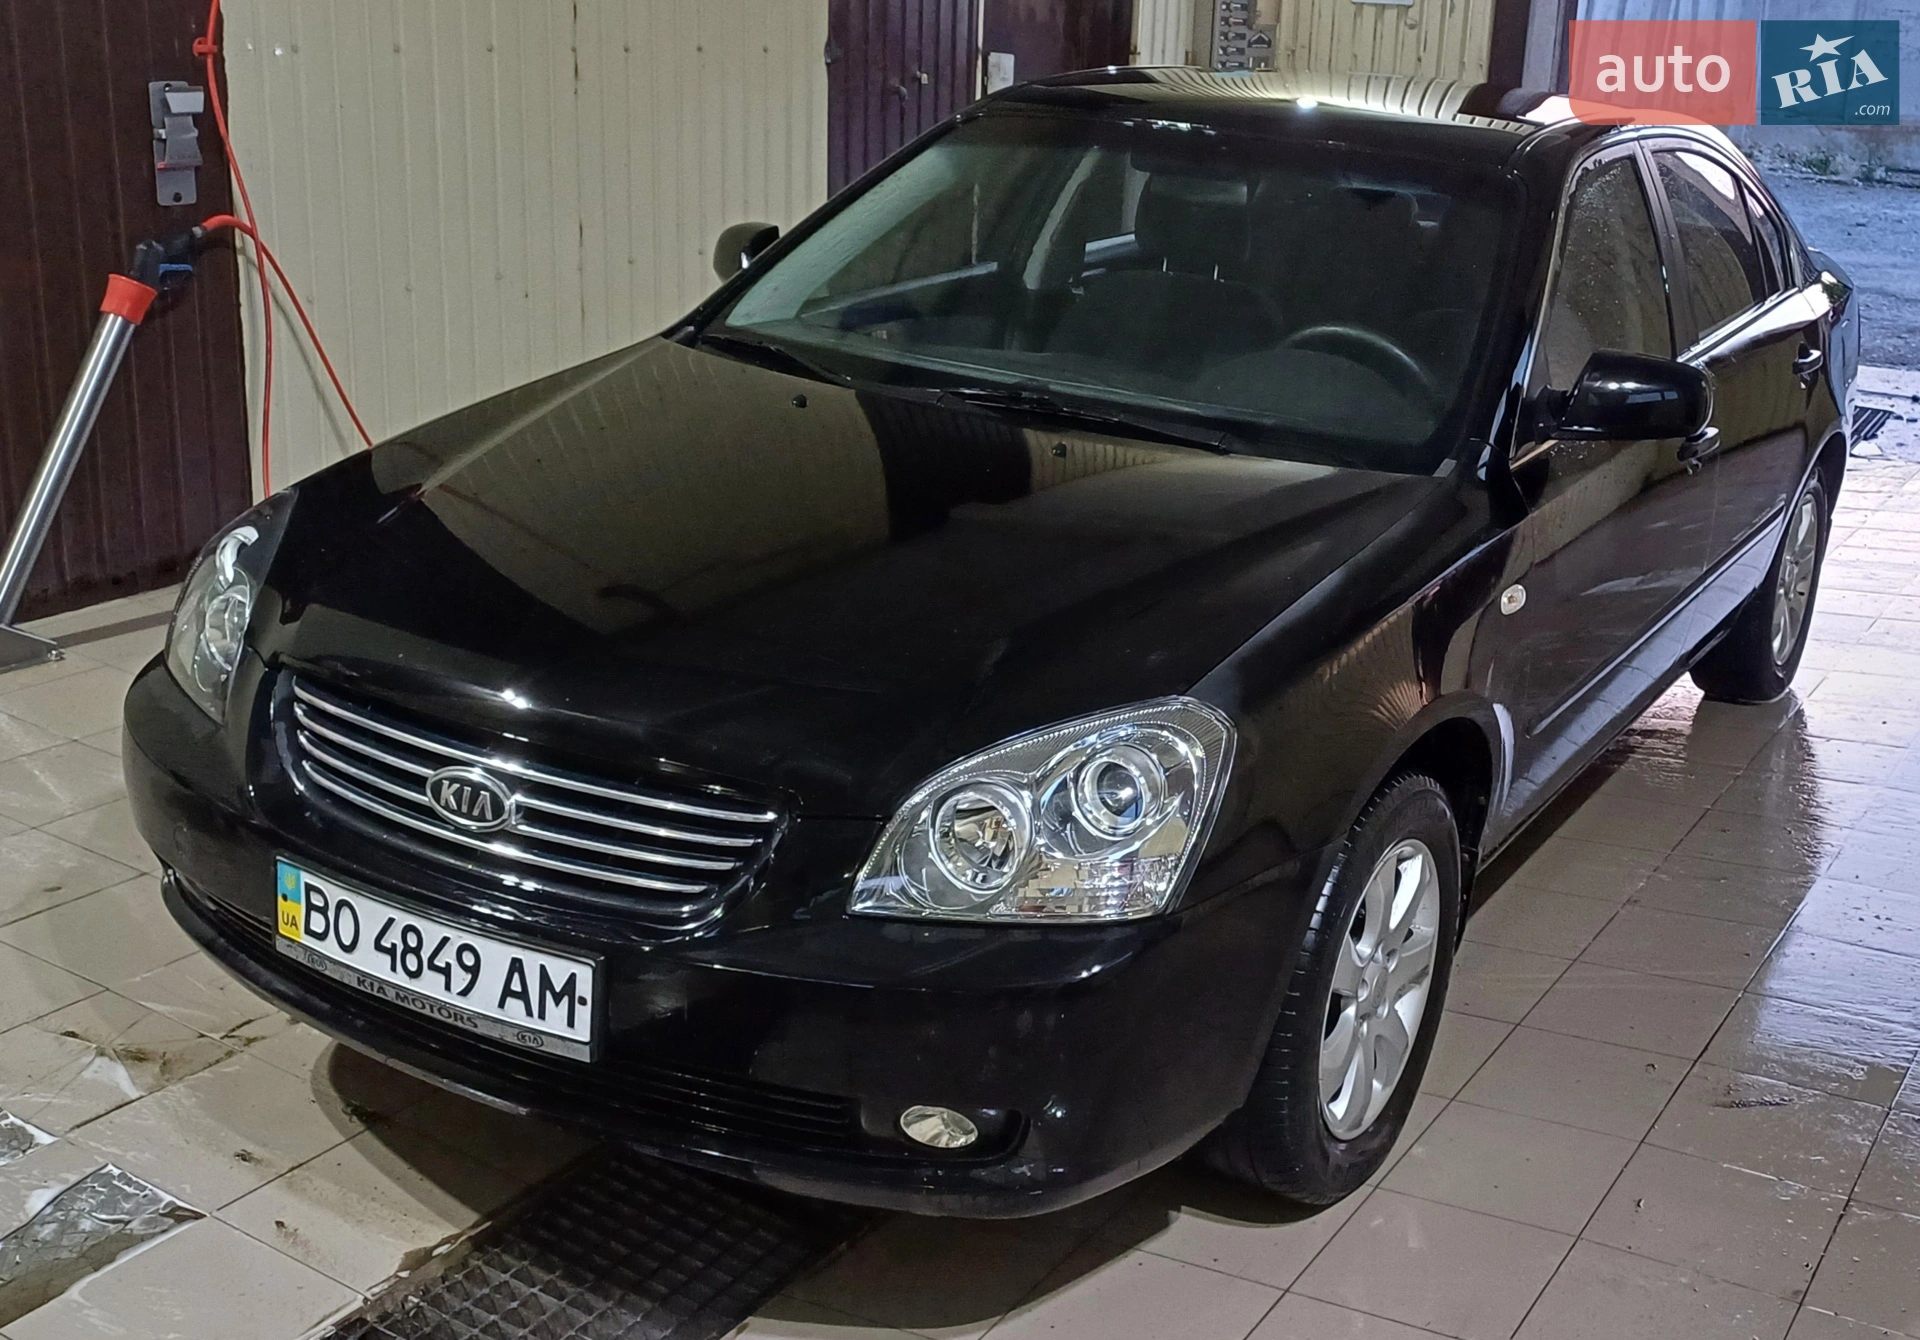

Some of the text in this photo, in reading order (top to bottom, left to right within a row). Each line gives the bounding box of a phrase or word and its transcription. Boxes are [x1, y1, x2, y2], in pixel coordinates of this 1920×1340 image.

[440, 779, 493, 820] KIA
[281, 913, 299, 931] UA
[304, 880, 577, 1029] BO 4849 AM
[356, 975, 479, 1029] KIA MOTORS
